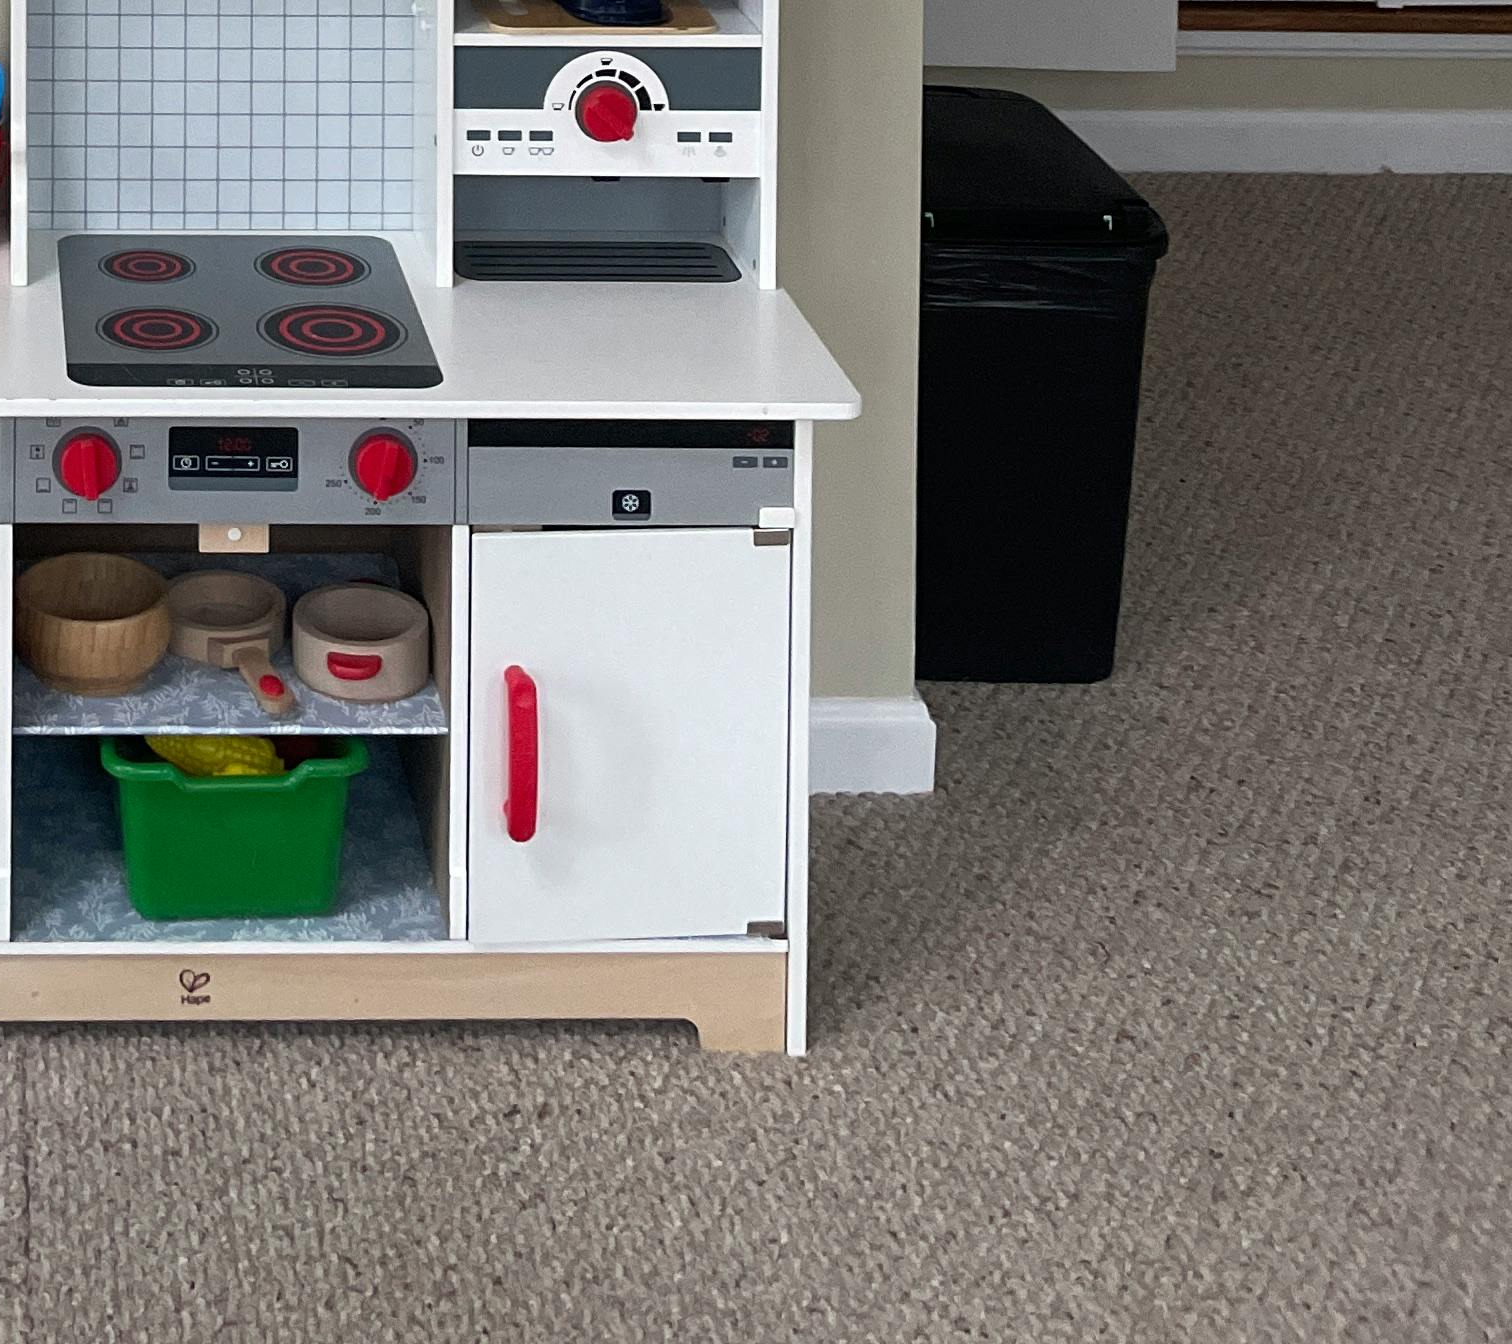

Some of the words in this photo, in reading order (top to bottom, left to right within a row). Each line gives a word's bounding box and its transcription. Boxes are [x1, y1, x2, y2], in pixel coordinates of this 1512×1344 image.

[429, 456, 445, 465] 100
[325, 479, 342, 488] 250
[411, 496, 427, 504] 150
[181, 995, 211, 1006] Hape
